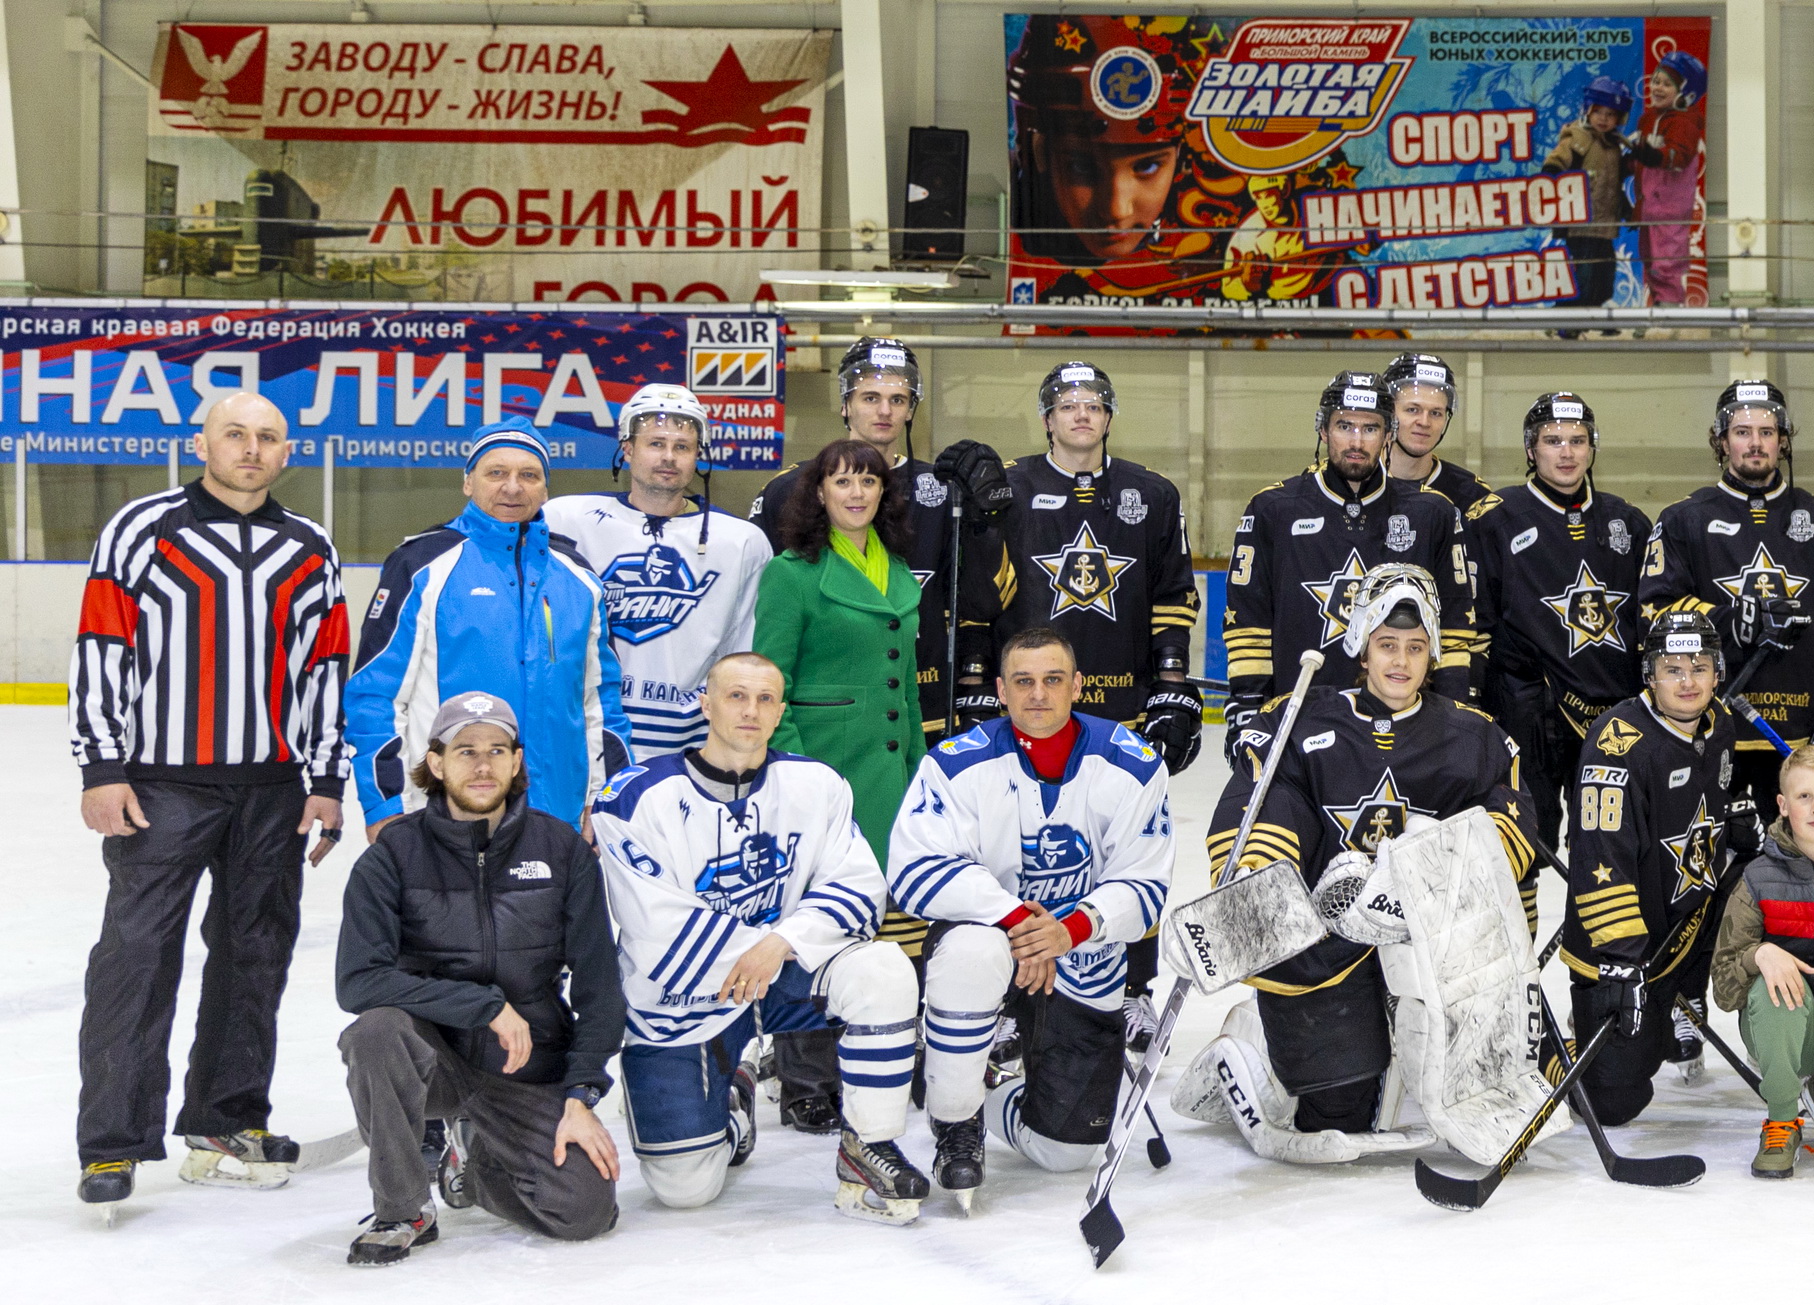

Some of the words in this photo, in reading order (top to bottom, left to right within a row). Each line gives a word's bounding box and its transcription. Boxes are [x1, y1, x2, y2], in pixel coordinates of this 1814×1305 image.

[1246, 26, 1349, 44] ПРИМОРСКИЙ
[1350, 26, 1393, 44] КРАЙ
[1430, 29, 1577, 45] ВСЕРОССИЙСКИЙ
[1585, 30, 1631, 44] КЛУБ
[285, 41, 449, 79] ЗАВОДУ
[478, 42, 616, 79] СЛАВА,
[1320, 46, 1370, 60] КАМЕНЬ
[1430, 47, 1485, 62] ЮНЫХ
[1494, 47, 1610, 62] ХОККЕИСТОВ
[1203, 63, 1385, 87] ЗОЛОТАЯ
[277, 86, 442, 125] ГОРОДУ
[467, 88, 624, 121] ЖИЗНЬ!
[1192, 83, 1372, 116] ШАЙБА
[1391, 111, 1534, 165] СПОРТ
[368, 175, 799, 248] ЛЮБИМЫЙ
[1304, 174, 1589, 245] НАЧИНАЕТСЯ
[1337, 270, 1368, 308] С
[1374, 247, 1576, 308] ДЕТСТВА
[92, 318, 200, 340] краевая
[211, 316, 361, 341] Федерация
[372, 319, 467, 339] Хоккея
[696, 320, 769, 344] A&IR
[1418, 367, 1445, 379] согаз
[0, 349, 260, 425] НАЯ
[299, 351, 615, 427] ЛИГА
[1738, 388, 1766, 397] согаз
[1345, 393, 1376, 404] согаз
[1554, 405, 1582, 414] согаз
[711, 426, 775, 441] ПАНИЯ
[550, 440, 577, 458] ая
[740, 448, 774, 461] ГРК
[610, 595, 698, 625] РАНИТ
[1668, 638, 1700, 649] согаз
[1077, 672, 1135, 688] ОРСКИЙ
[1074, 689, 1106, 704] РАЙ
[1582, 767, 1628, 786] PARI
[1580, 786, 1624, 831] 88
[510, 867, 537, 875] NORTH
[1526, 982, 1541, 1061] CCM
[1217, 1058, 1262, 1129] CCM
